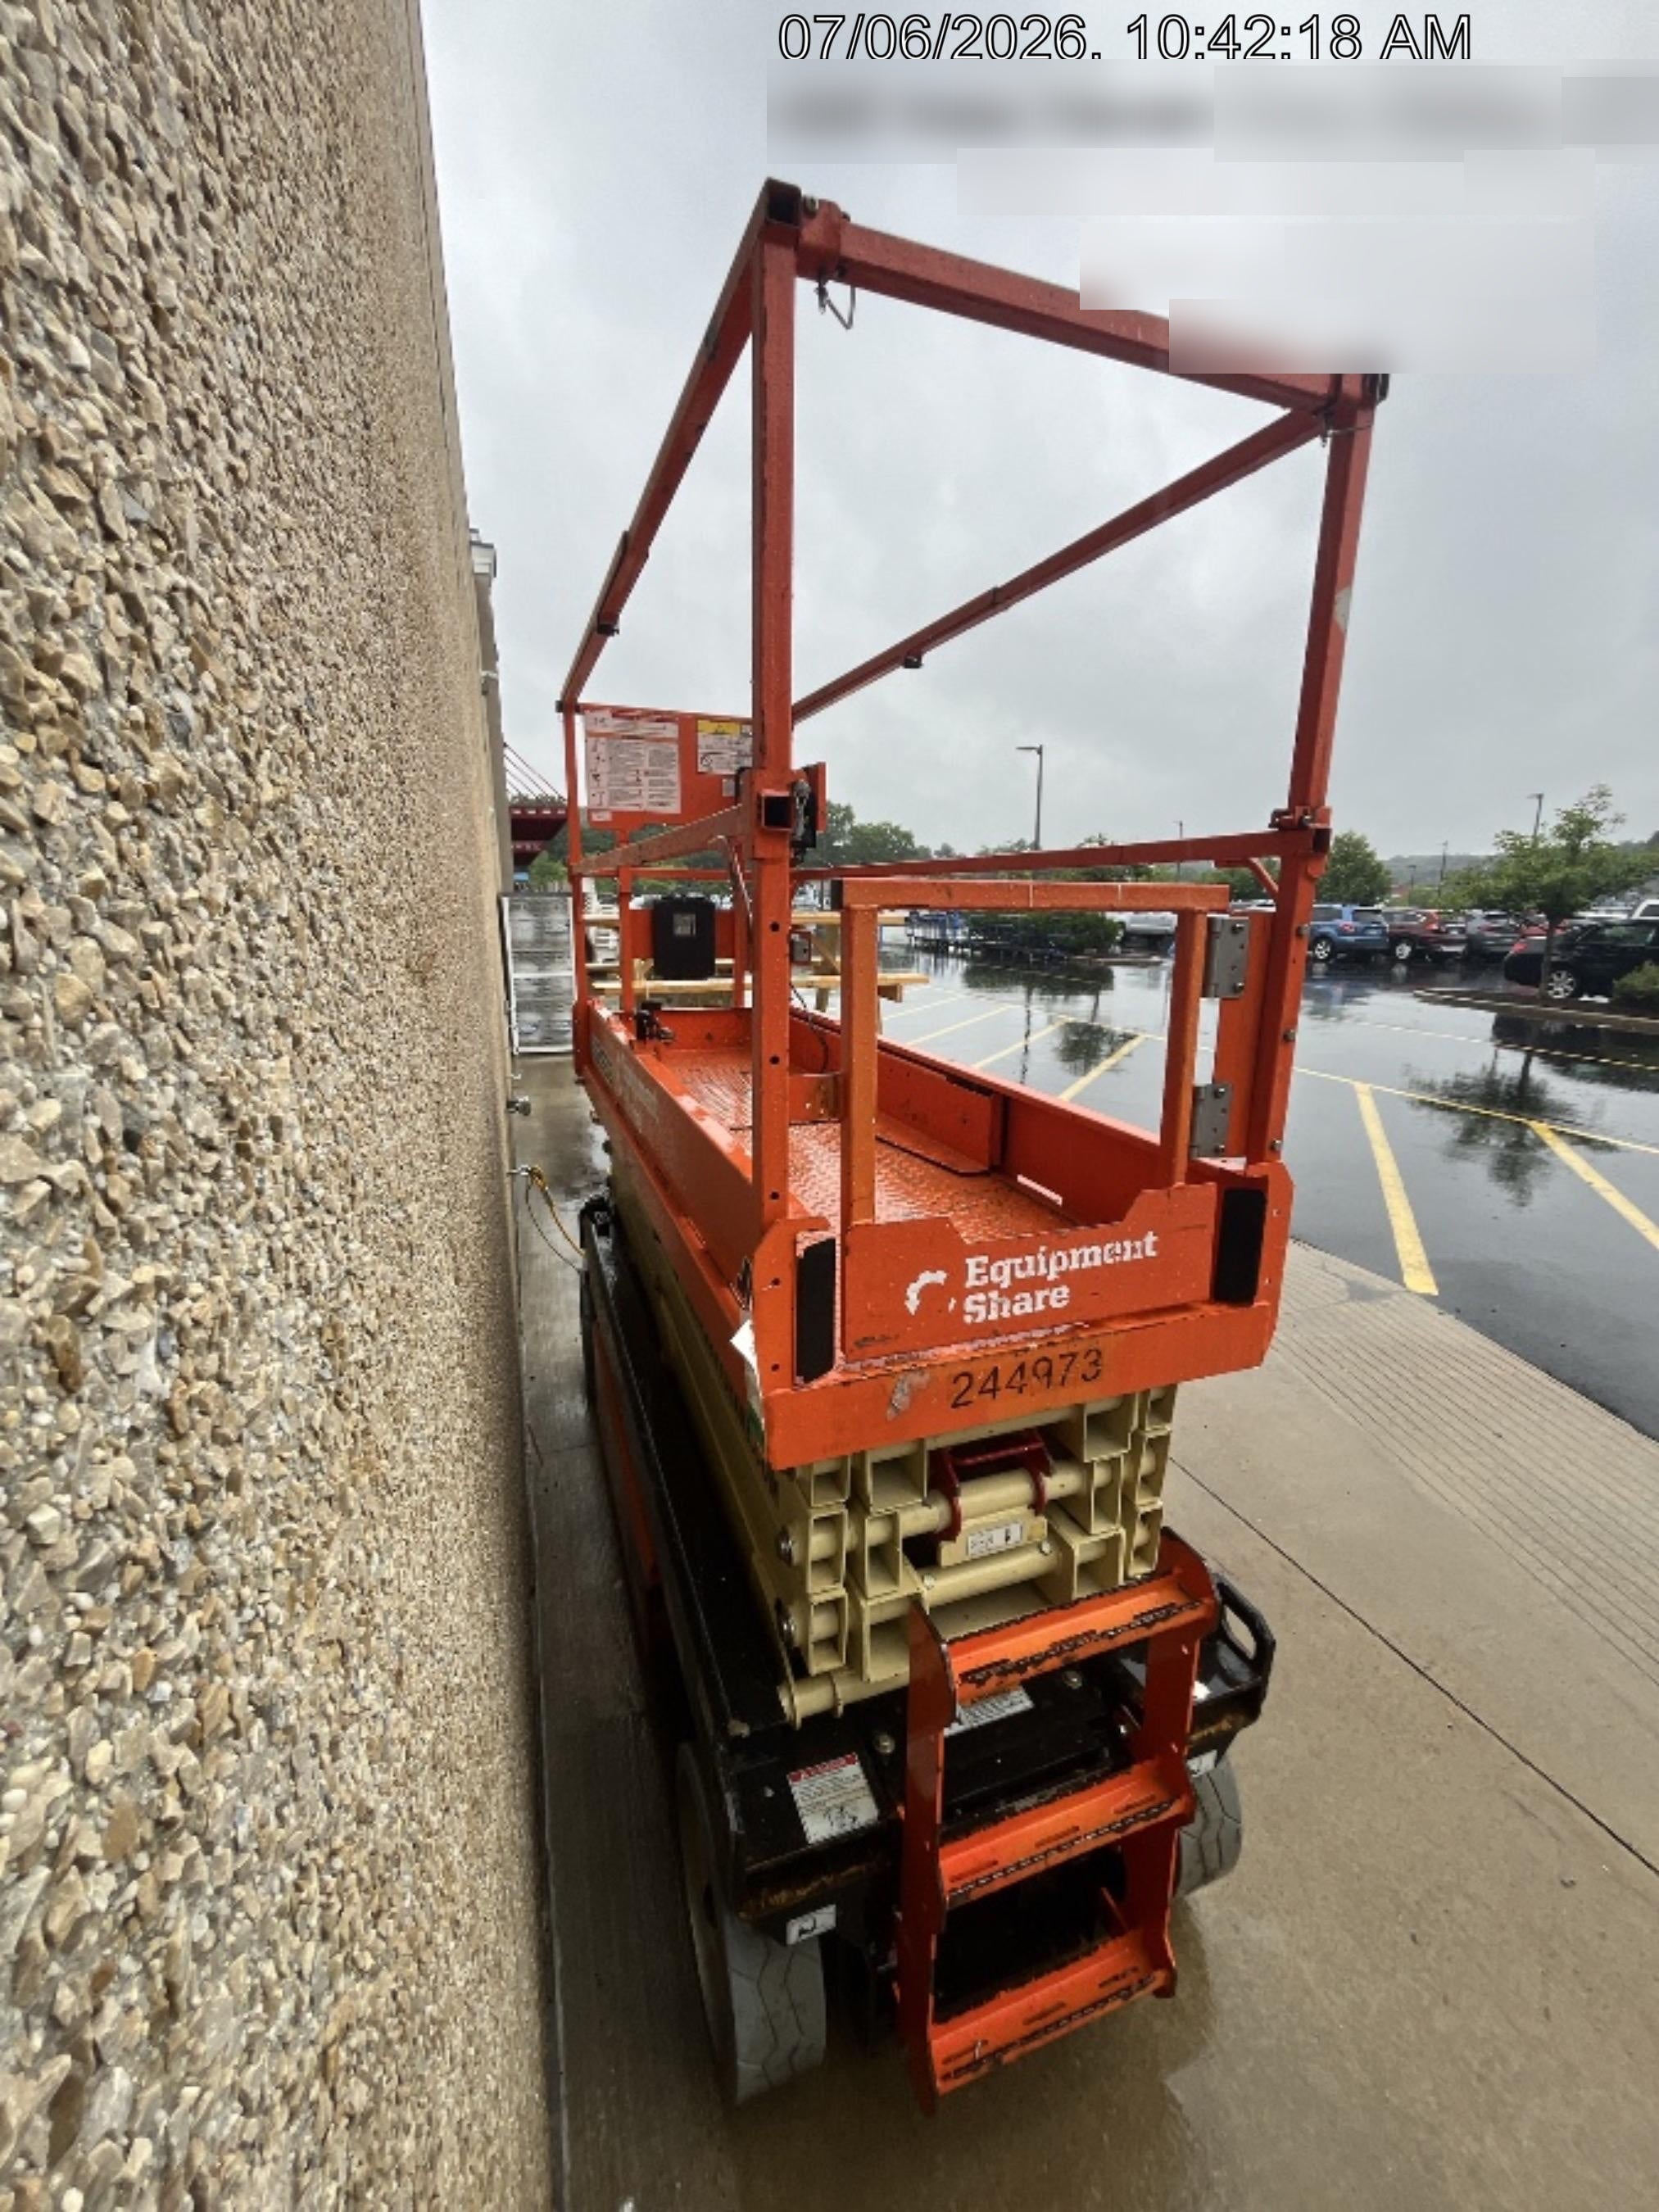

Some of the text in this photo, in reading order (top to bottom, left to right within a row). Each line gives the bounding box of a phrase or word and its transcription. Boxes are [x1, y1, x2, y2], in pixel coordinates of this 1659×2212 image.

[964, 1231, 1159, 1289] Equipment
[963, 1284, 1071, 1325] Share
[950, 1348, 1104, 1410] 244973
